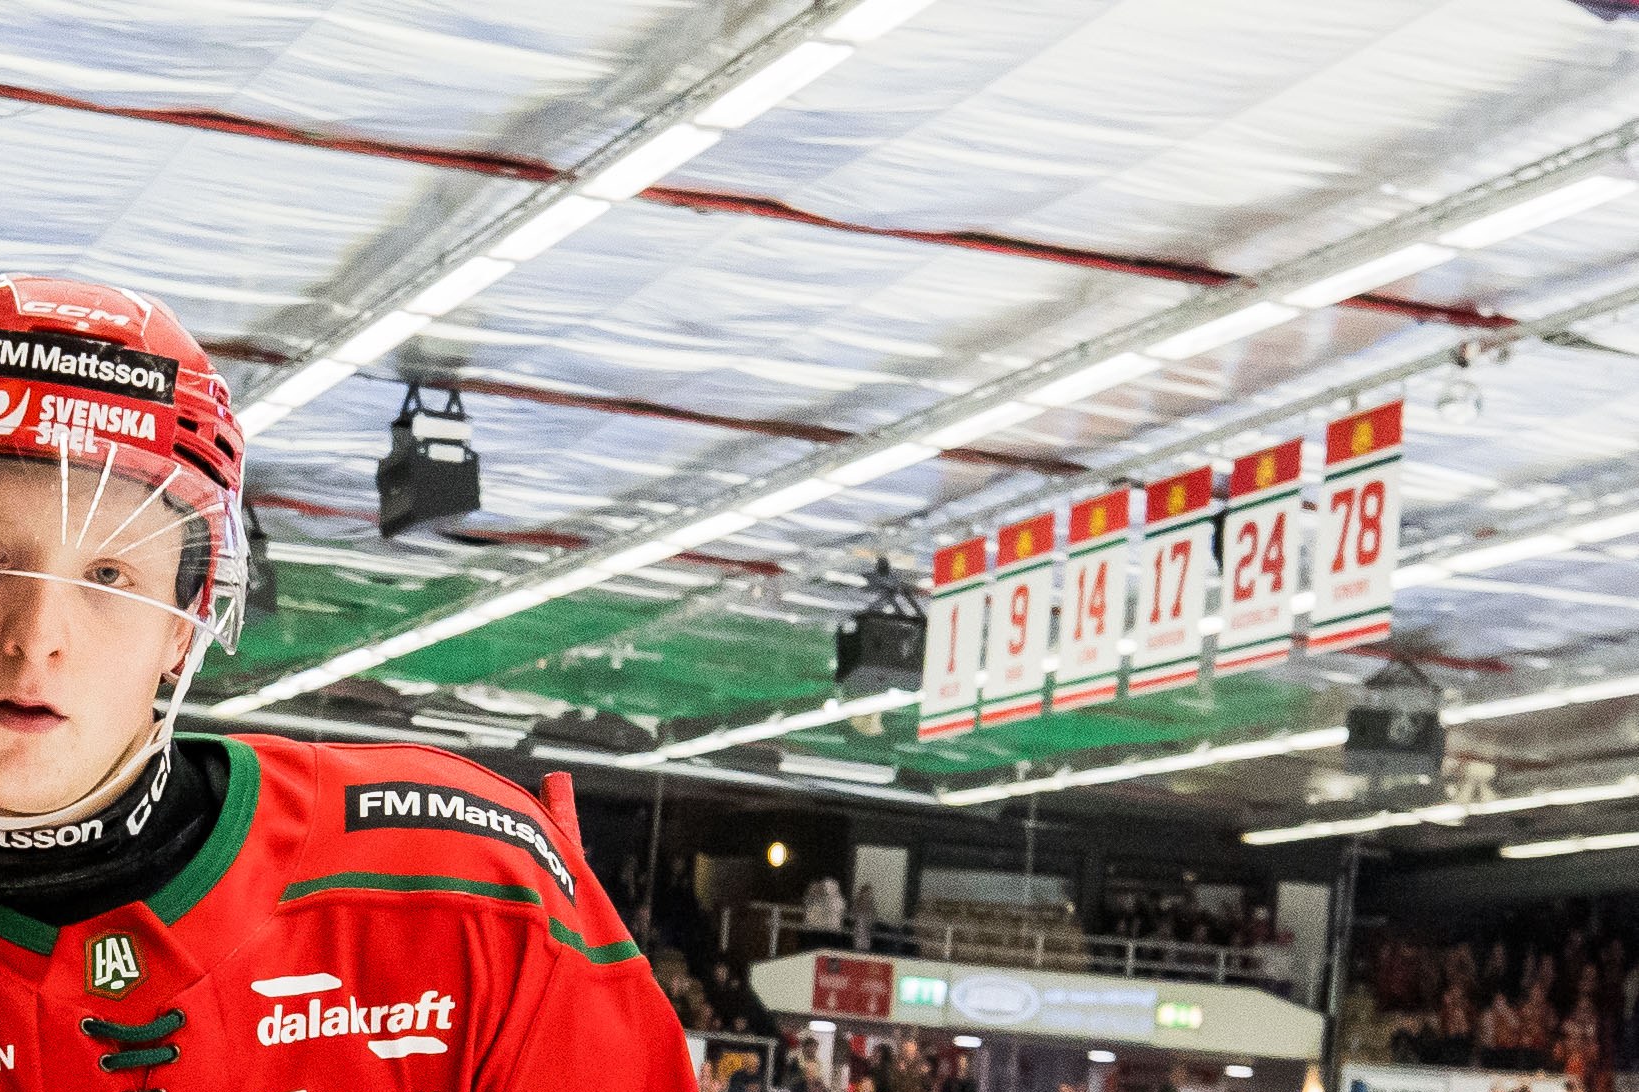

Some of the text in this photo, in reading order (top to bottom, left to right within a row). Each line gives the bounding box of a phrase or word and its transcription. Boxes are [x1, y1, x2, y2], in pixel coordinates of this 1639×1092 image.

[22, 300, 131, 326] CCM
[31, 344, 166, 392] Mattsson
[35, 421, 98, 454] SPEL
[40, 394, 156, 442] SVENSKA
[1232, 512, 1287, 602] 24
[1331, 480, 1385, 574] 78
[1074, 560, 1108, 641] 14
[1150, 540, 1192, 624] 17
[947, 604, 959, 674] 1
[1007, 584, 1029, 656] 9
[126, 742, 172, 836] CC
[359, 790, 575, 896] FM Mattsson
[256, 990, 455, 1047] dalakraft
